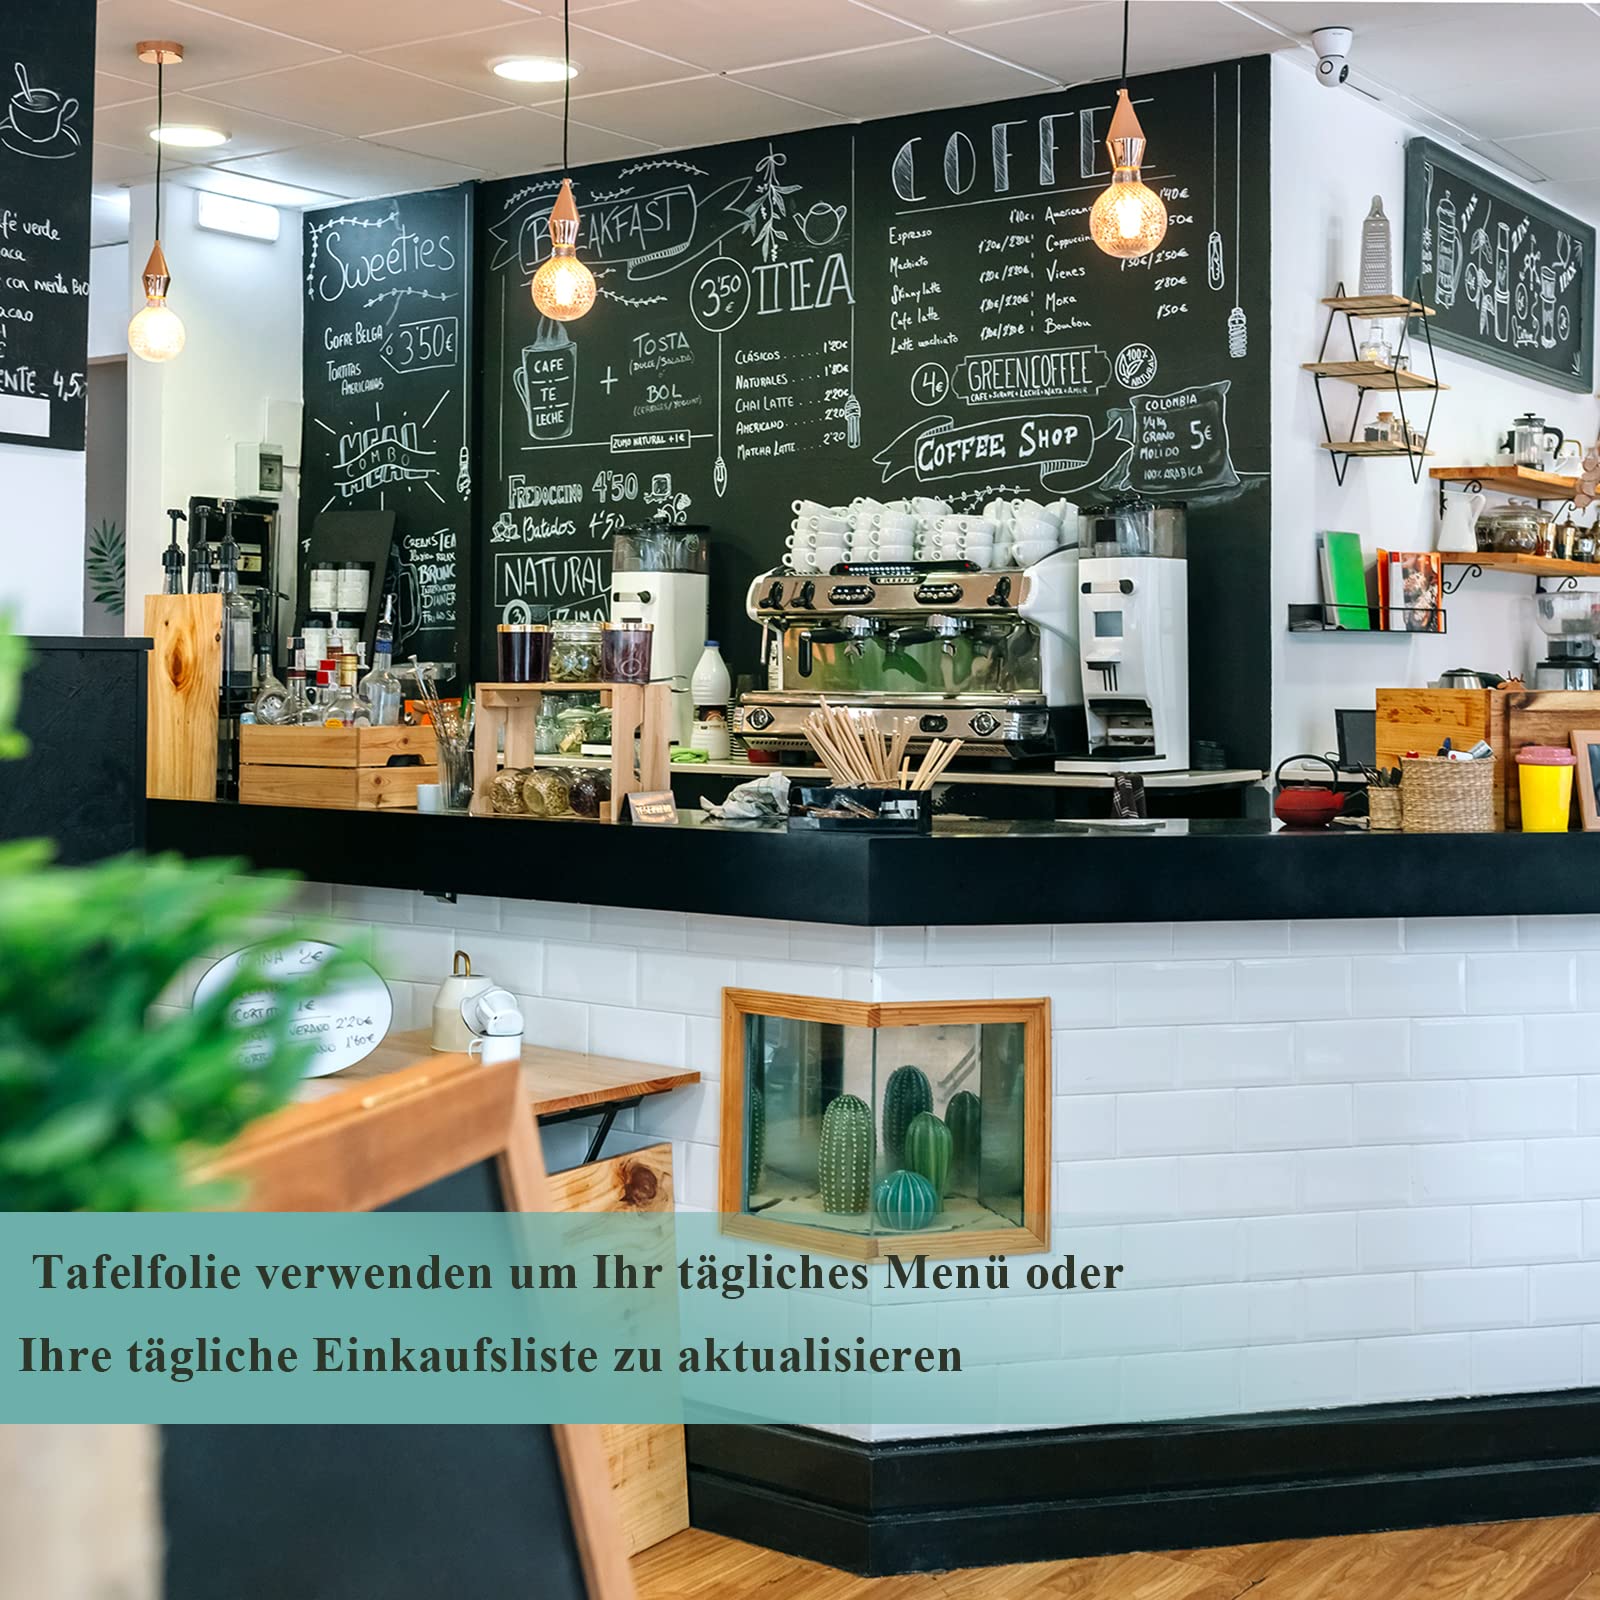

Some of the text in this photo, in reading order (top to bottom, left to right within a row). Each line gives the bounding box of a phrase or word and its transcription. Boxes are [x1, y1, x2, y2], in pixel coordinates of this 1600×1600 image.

[891, 98, 1156, 202] COFFE
[0, 210, 61, 241] fé verde
[521, 191, 689, 266] BEAKFAST
[889, 226, 932, 246] Espresso
[1045, 214, 1194, 252] Cappuccin 50€
[1046, 259, 1086, 282] Vienes
[0, 306, 34, 322] acao
[324, 321, 383, 351] GOFRE BELGA
[632, 331, 690, 359] TOSTA
[533, 358, 564, 374] CAFE
[540, 387, 557, 402] TE
[646, 383, 683, 404] BOL
[735, 398, 761, 414] CHAI
[763, 396, 794, 411] LATTE
[1145, 394, 1198, 412] COLOMBIA
[535, 410, 565, 427] LECHE
[632, 434, 667, 447] NATURAL
[917, 421, 1078, 472] COFFEE SHOP
[523, 515, 577, 543] Batidos
[504, 556, 614, 598] NATURAL
